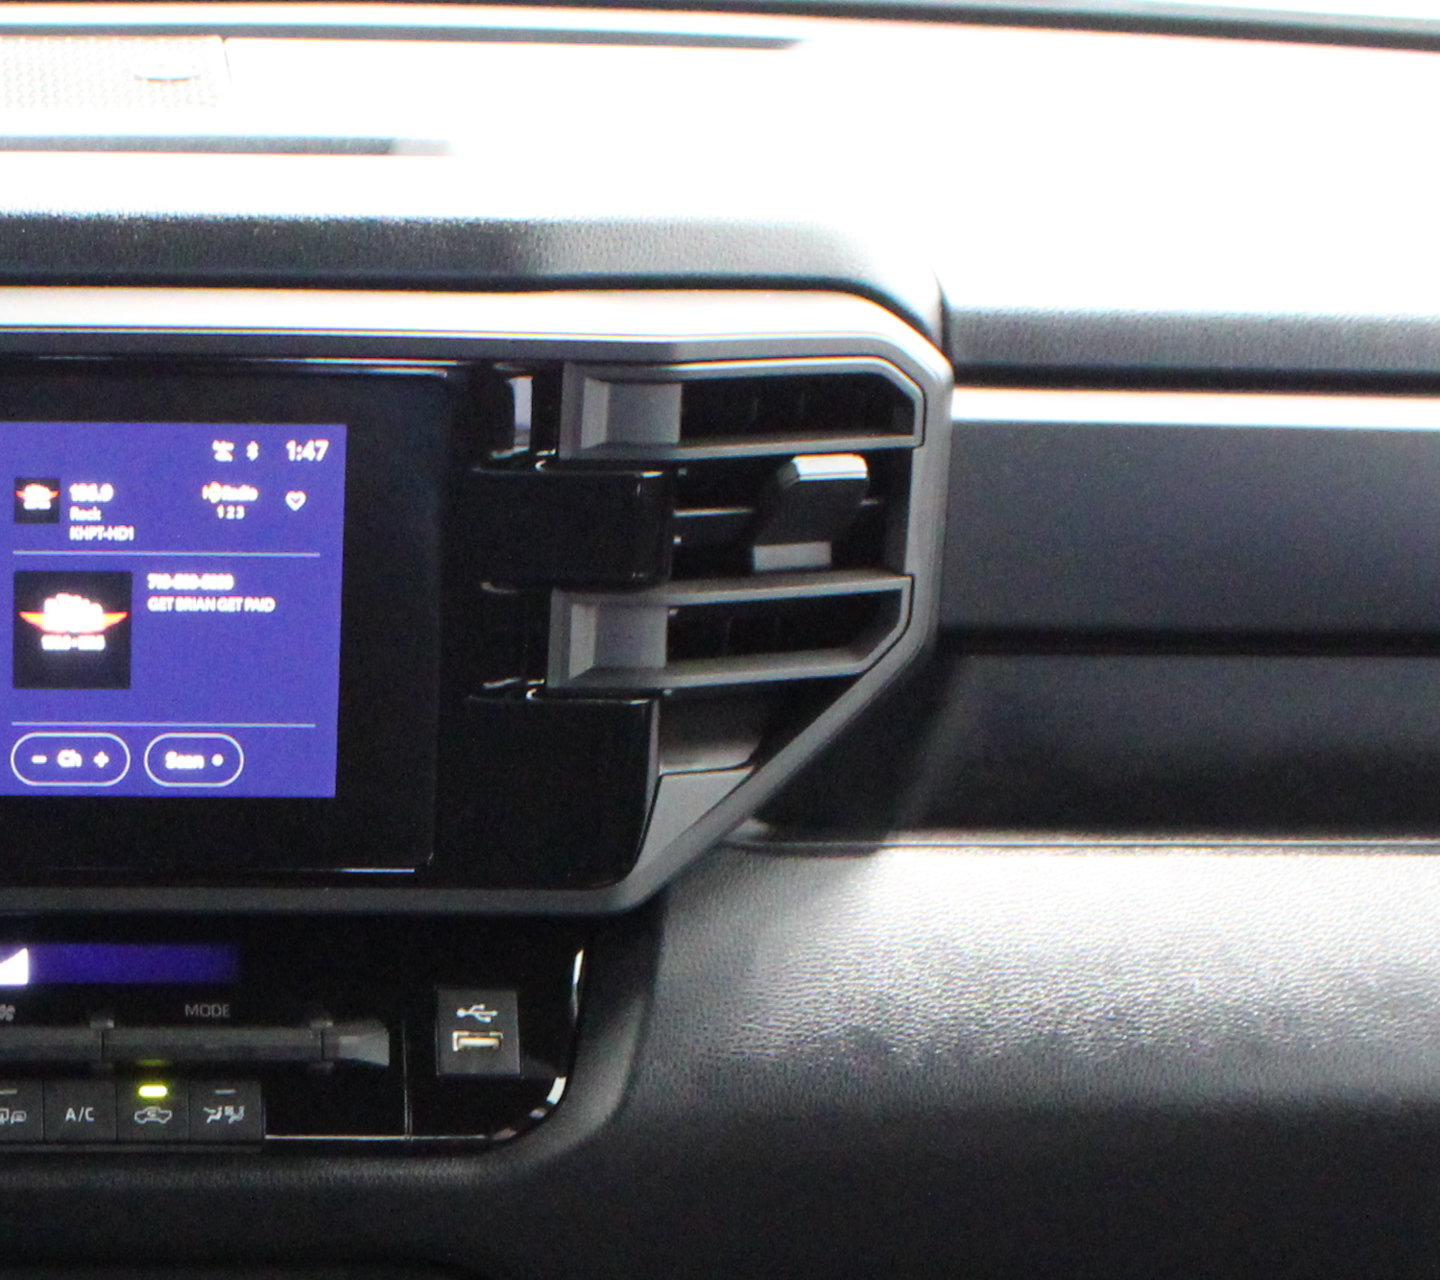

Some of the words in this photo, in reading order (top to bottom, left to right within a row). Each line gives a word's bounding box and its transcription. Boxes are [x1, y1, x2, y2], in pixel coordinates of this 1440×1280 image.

[285, 439, 329, 462] 1:47
[185, 1004, 231, 1017] MODE
[65, 1107, 95, 1122] A/C
